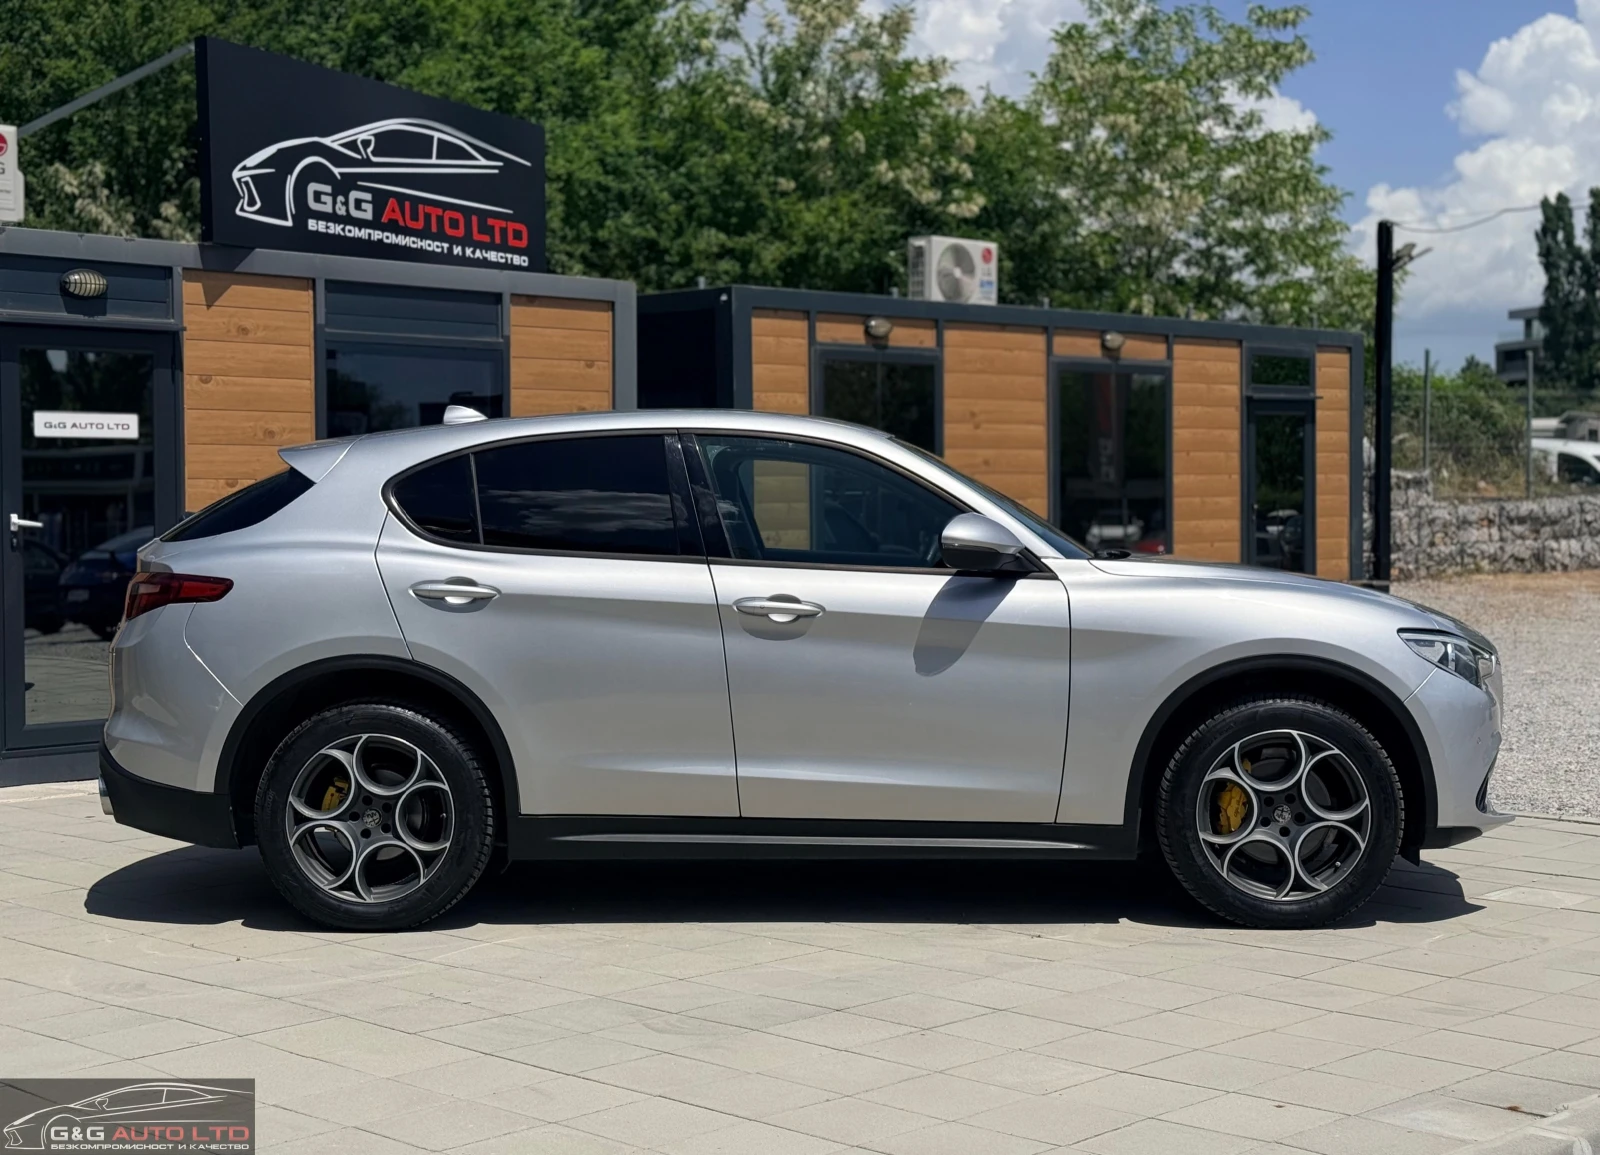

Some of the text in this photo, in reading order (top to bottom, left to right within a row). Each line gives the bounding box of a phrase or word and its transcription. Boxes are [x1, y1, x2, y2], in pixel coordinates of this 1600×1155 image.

[307, 182, 528, 248] G&G AUTO LTD
[307, 218, 529, 267] БЕЗКОМПРОМИСНОСТ И КАЧЕСТВО
[70, 422, 105, 430] AUTO
[107, 423, 130, 431] LTD
